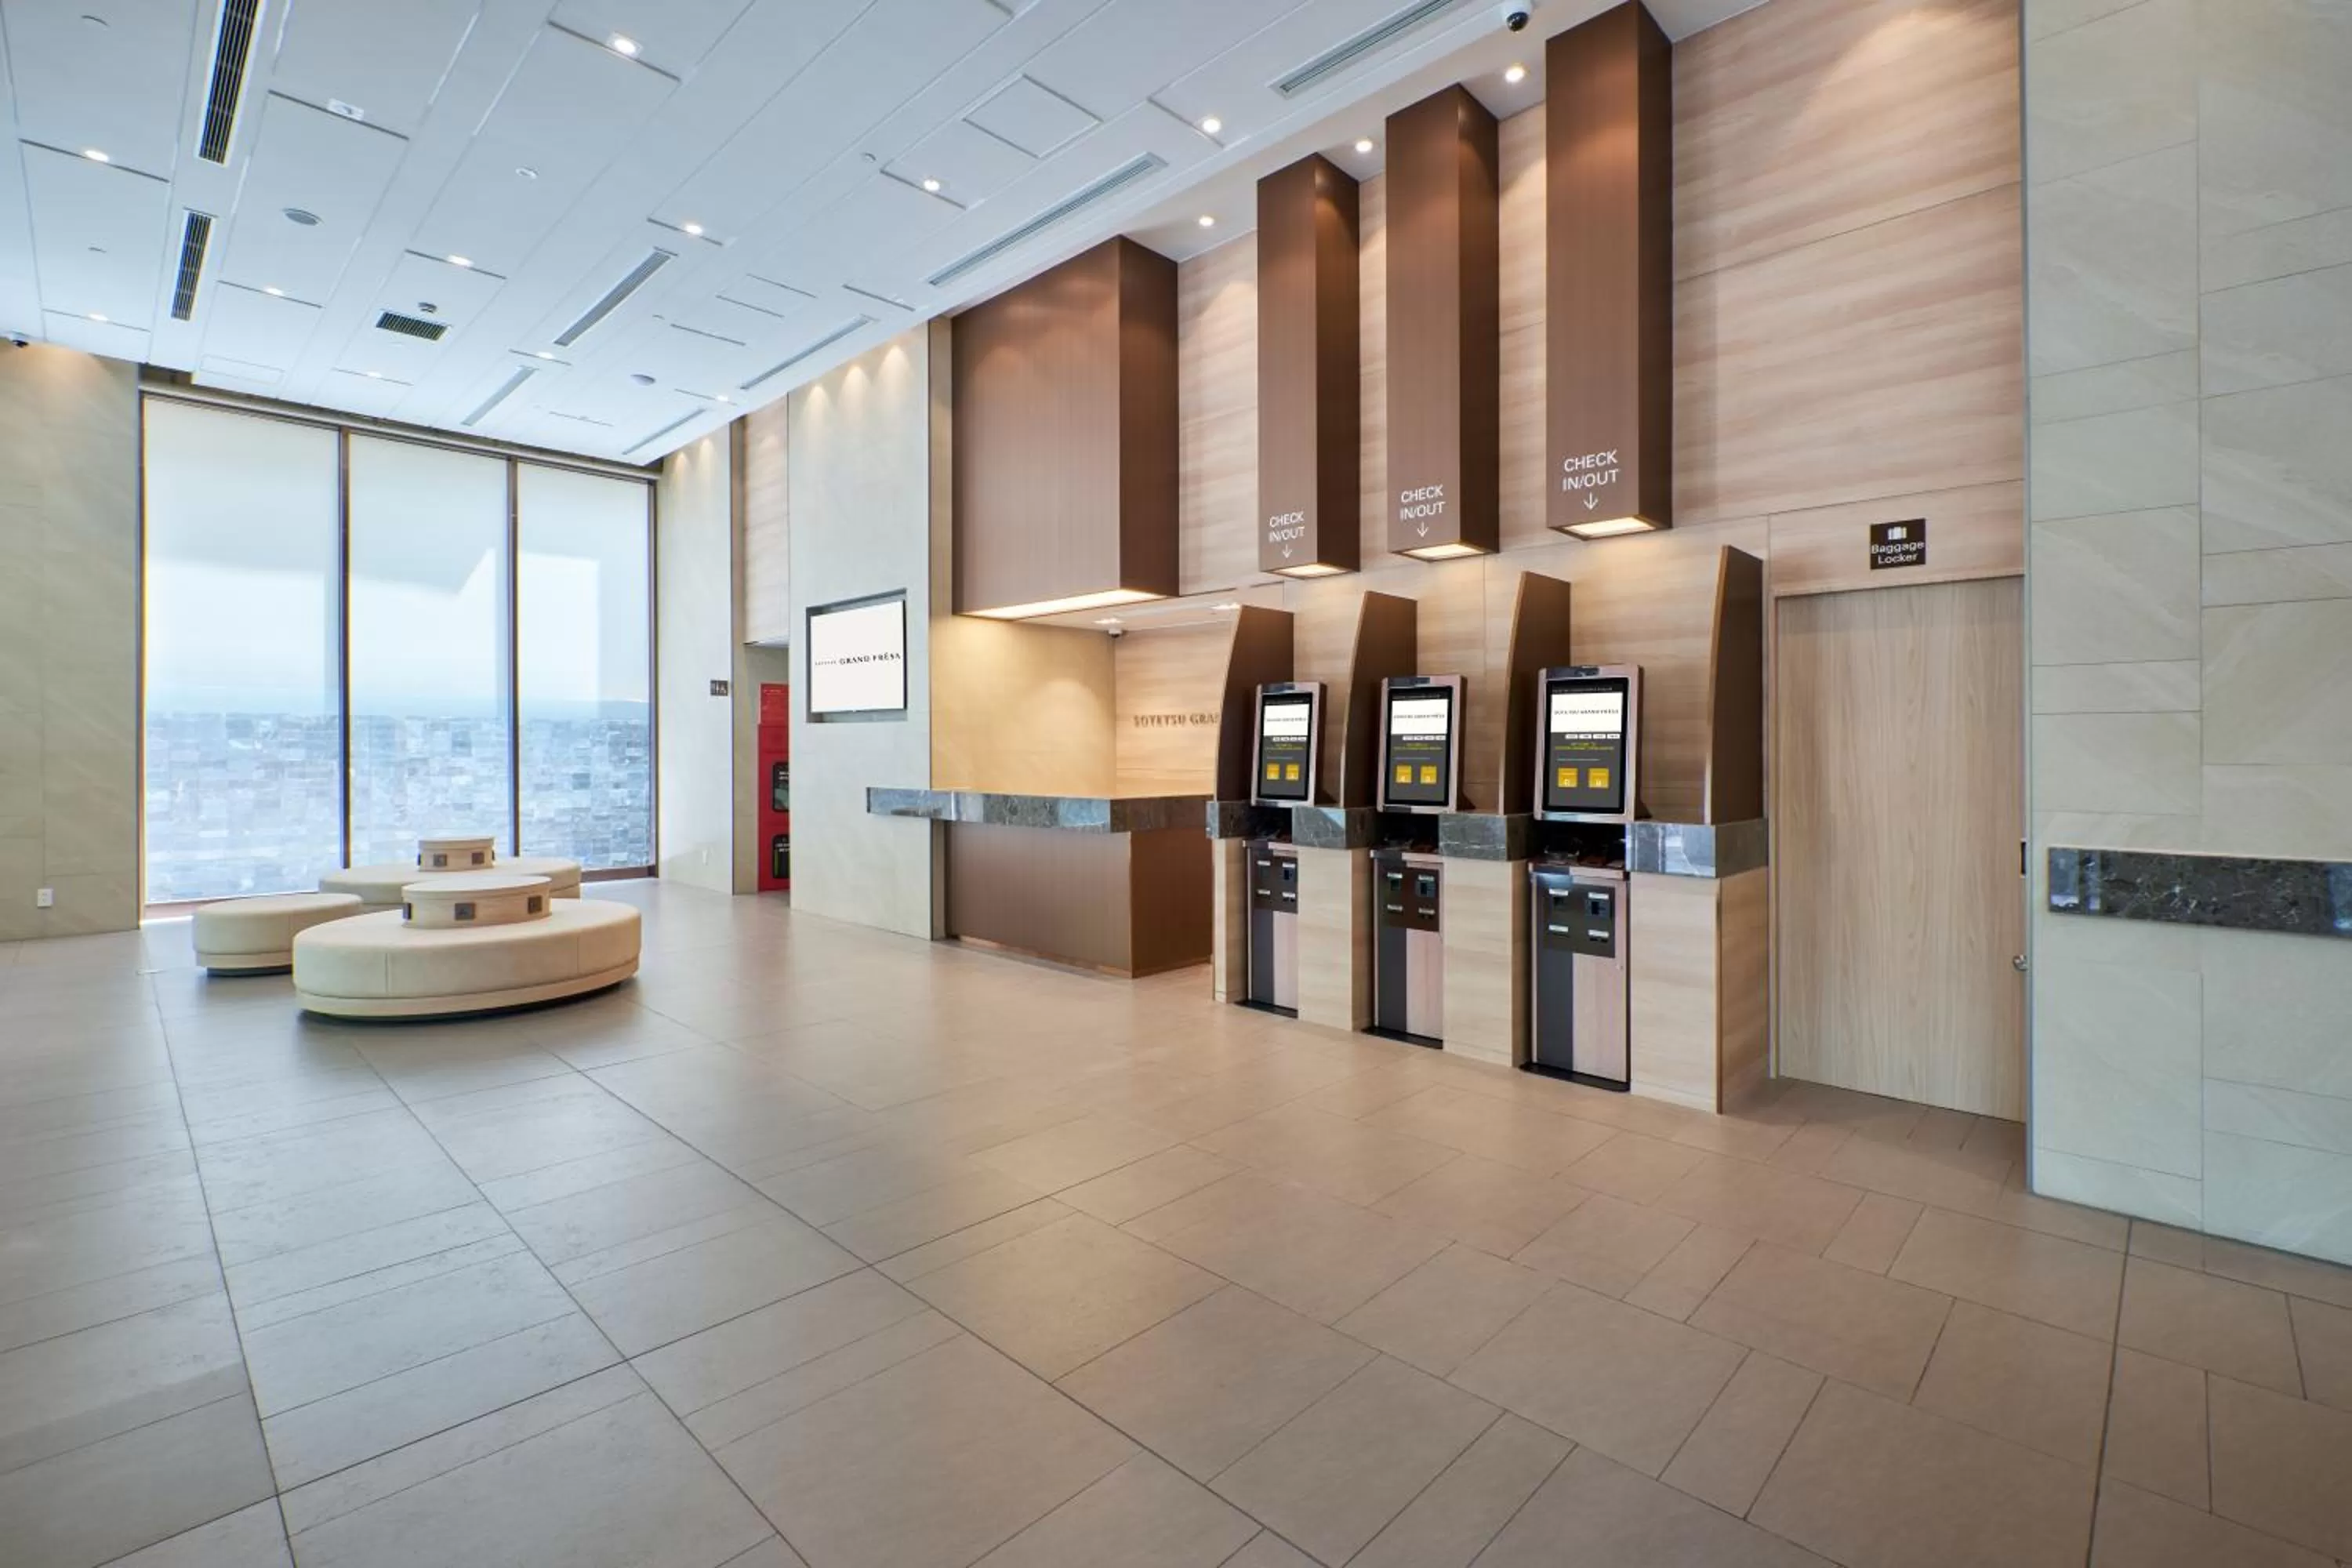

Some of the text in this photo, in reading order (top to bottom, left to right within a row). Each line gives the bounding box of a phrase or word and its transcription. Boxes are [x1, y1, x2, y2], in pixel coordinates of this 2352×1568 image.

[1563, 448, 1618, 472] CHECK
[1562, 469, 1620, 492] IN/OUT
[1400, 484, 1443, 503] CHECK
[1269, 511, 1305, 527] CHECK
[1399, 502, 1446, 521] IN/OUT
[1269, 526, 1305, 542] IN/OUT
[1871, 542, 1925, 554] Baggage
[1878, 554, 1918, 564] Locker
[839, 656, 869, 665] GRAND
